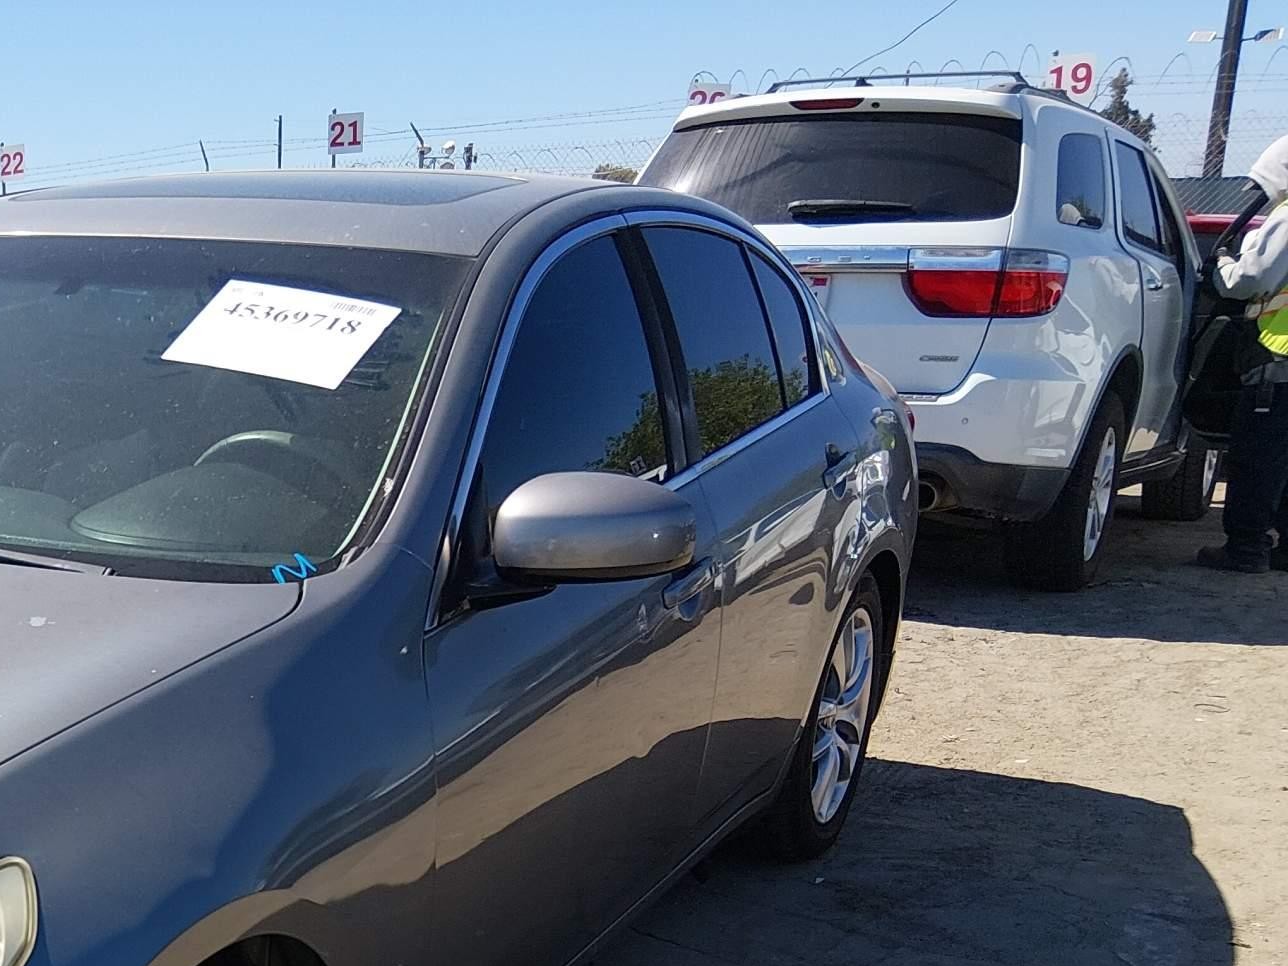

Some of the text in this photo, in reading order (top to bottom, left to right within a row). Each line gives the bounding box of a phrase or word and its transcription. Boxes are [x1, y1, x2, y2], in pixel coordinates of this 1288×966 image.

[1050, 63, 1092, 94] 19
[330, 120, 361, 147] 21
[1, 152, 24, 176] 22
[224, 302, 362, 334] 45369718
